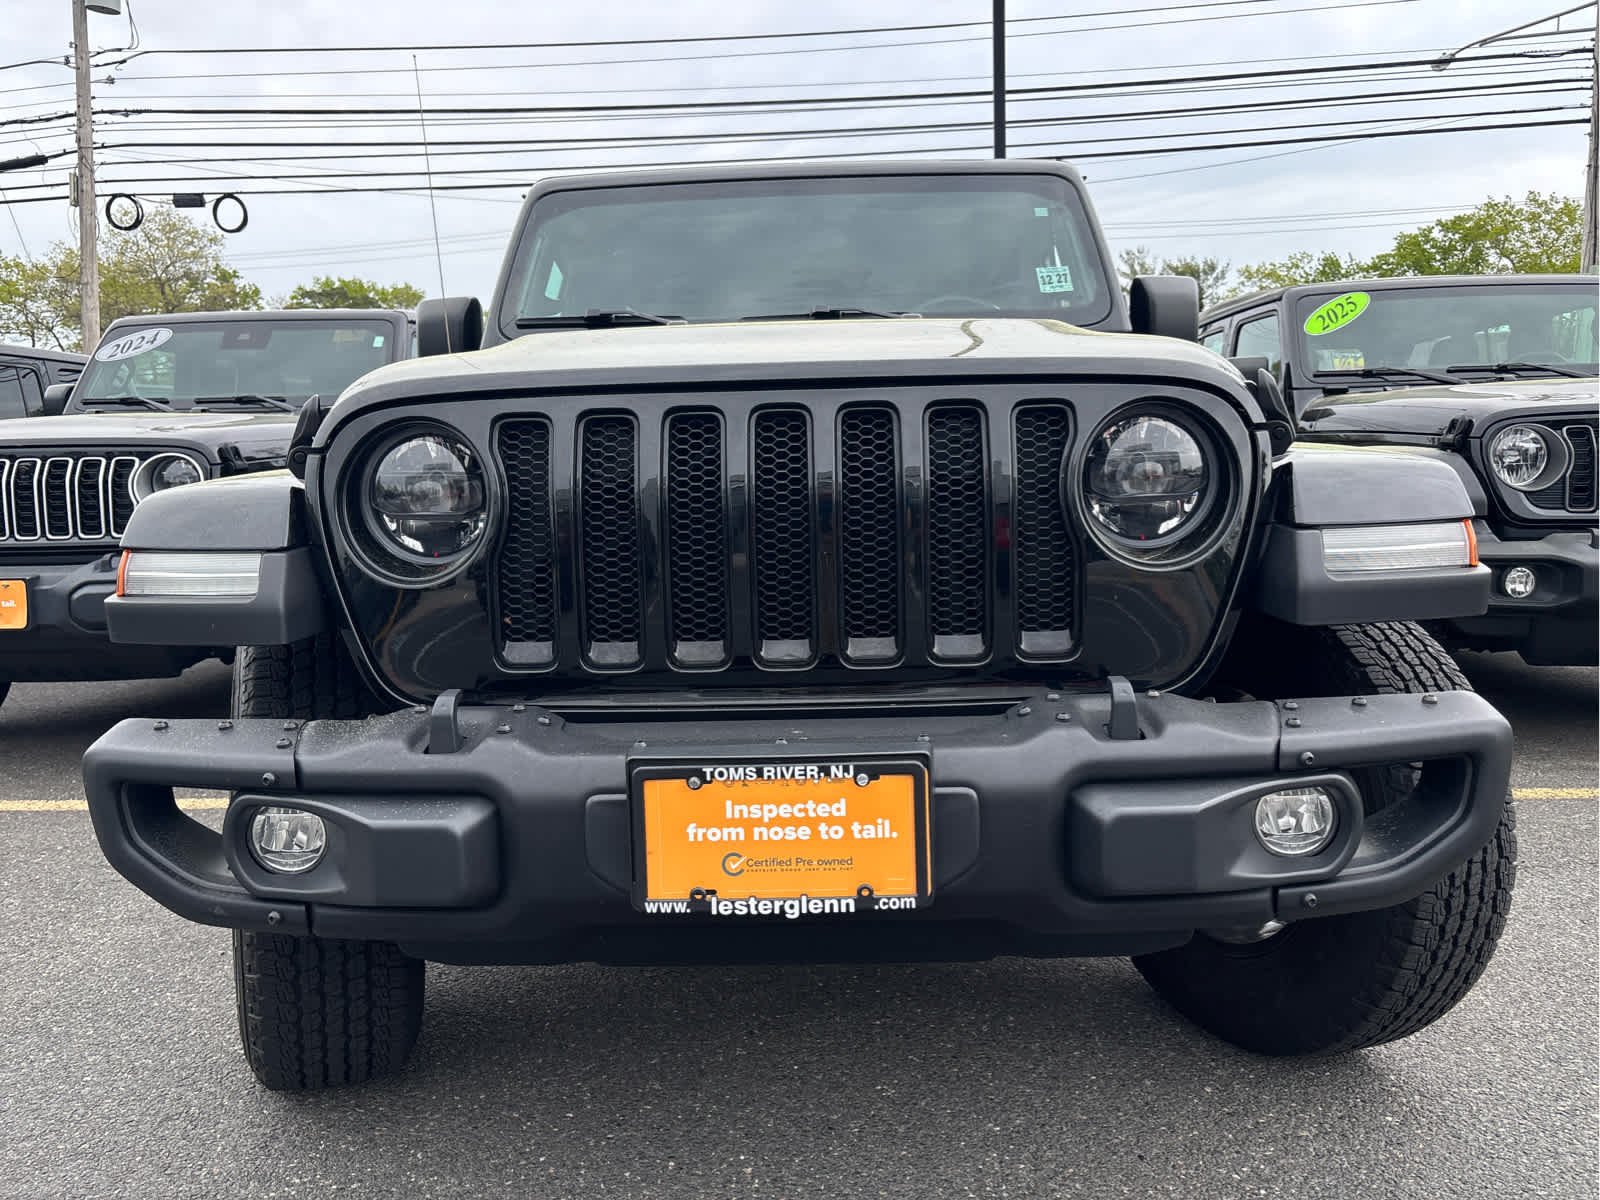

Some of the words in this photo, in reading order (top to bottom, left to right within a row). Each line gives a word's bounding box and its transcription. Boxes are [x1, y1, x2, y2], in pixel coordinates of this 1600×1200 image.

[1040, 275, 1053, 285] 12
[1056, 273, 1068, 284] 27
[1316, 295, 1357, 331] 2025
[107, 330, 160, 358] 2024
[702, 767, 757, 781] TOMS
[763, 765, 824, 780] RIVER,
[831, 765, 854, 779] NJ
[725, 798, 847, 823] Inspected
[686, 823, 745, 842] from
[753, 825, 812, 841] nose
[818, 822, 844, 840] to
[851, 818, 899, 839] tail.
[746, 857, 792, 868] Certified
[645, 901, 691, 914] www.
[711, 896, 856, 919] lesterglenn
[874, 896, 916, 910] .com
